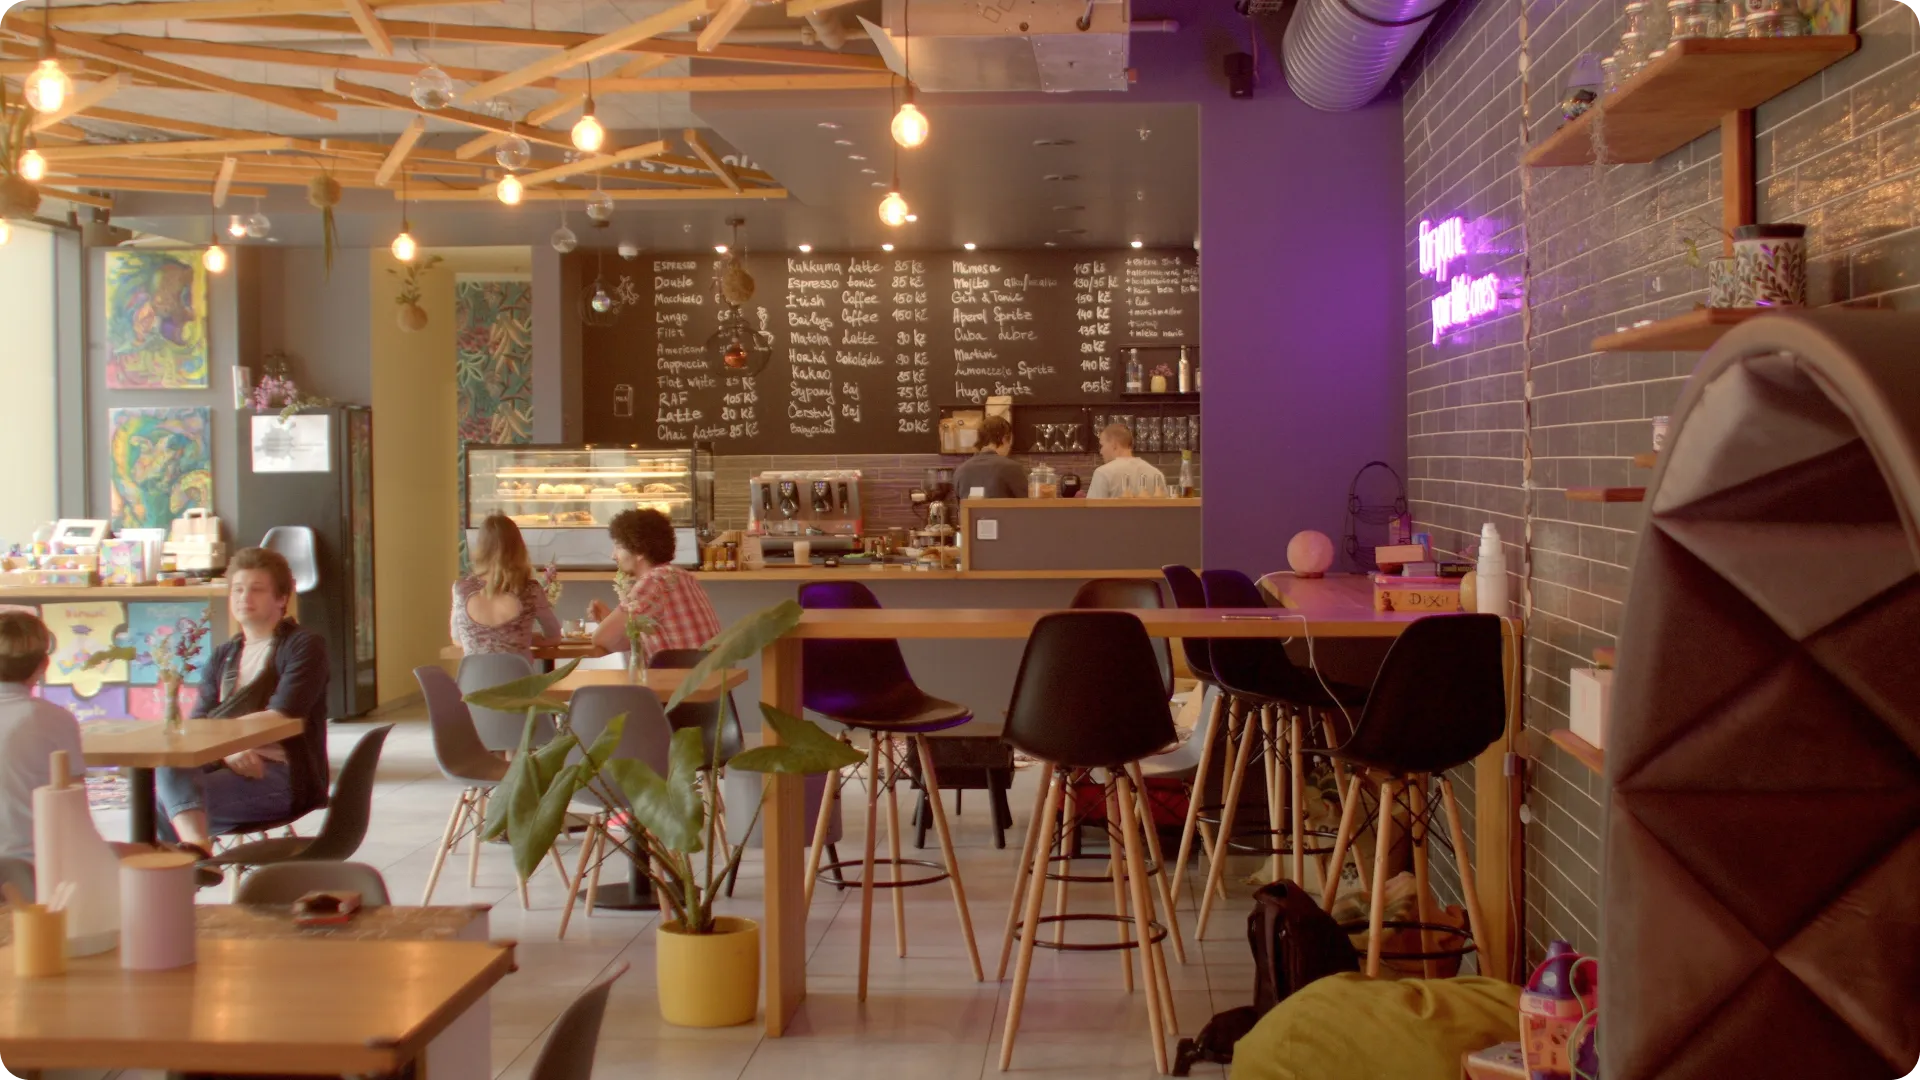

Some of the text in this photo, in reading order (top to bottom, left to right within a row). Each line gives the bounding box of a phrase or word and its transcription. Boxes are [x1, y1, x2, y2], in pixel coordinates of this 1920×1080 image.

[894, 260, 911, 273] 85
[952, 259, 1002, 275] Mimosa
[654, 274, 694, 291] Double
[787, 277, 840, 293] Espresso
[846, 274, 878, 289] tonic
[891, 276, 909, 289] 85
[952, 276, 991, 296] Mojito
[654, 292, 704, 307] Macchiato
[785, 291, 826, 309] Irish
[841, 290, 880, 310] Coffee
[892, 292, 914, 305] 150
[951, 291, 977, 305] Gin
[990, 289, 1025, 304] Tonic
[1074, 291, 1097, 306] 150
[655, 311, 689, 327] Lungo
[787, 310, 834, 332] Baileys
[841, 307, 881, 328] Coffee
[891, 308, 914, 324] 150
[952, 307, 988, 328] Aperol
[993, 305, 1034, 327] Spritz
[790, 331, 833, 347] Matcha
[953, 327, 988, 342] Cuba
[1077, 324, 1097, 338] 135
[656, 342, 707, 357] American
[953, 347, 999, 362] Martini
[656, 357, 709, 374] Cappuccin
[791, 364, 832, 381] Kakao
[1017, 360, 1057, 380] Spritz
[656, 375, 684, 388] Flat
[686, 373, 717, 390] white
[658, 391, 689, 408] RAF
[722, 393, 742, 406] 105
[955, 380, 990, 405] Hugo
[994, 380, 1037, 397] Spritz
[1080, 379, 1101, 394] 135
[655, 407, 704, 423] Latte
[656, 424, 689, 441] Chai
[897, 417, 914, 433] 20
[1408, 592, 1449, 608] Dixit
